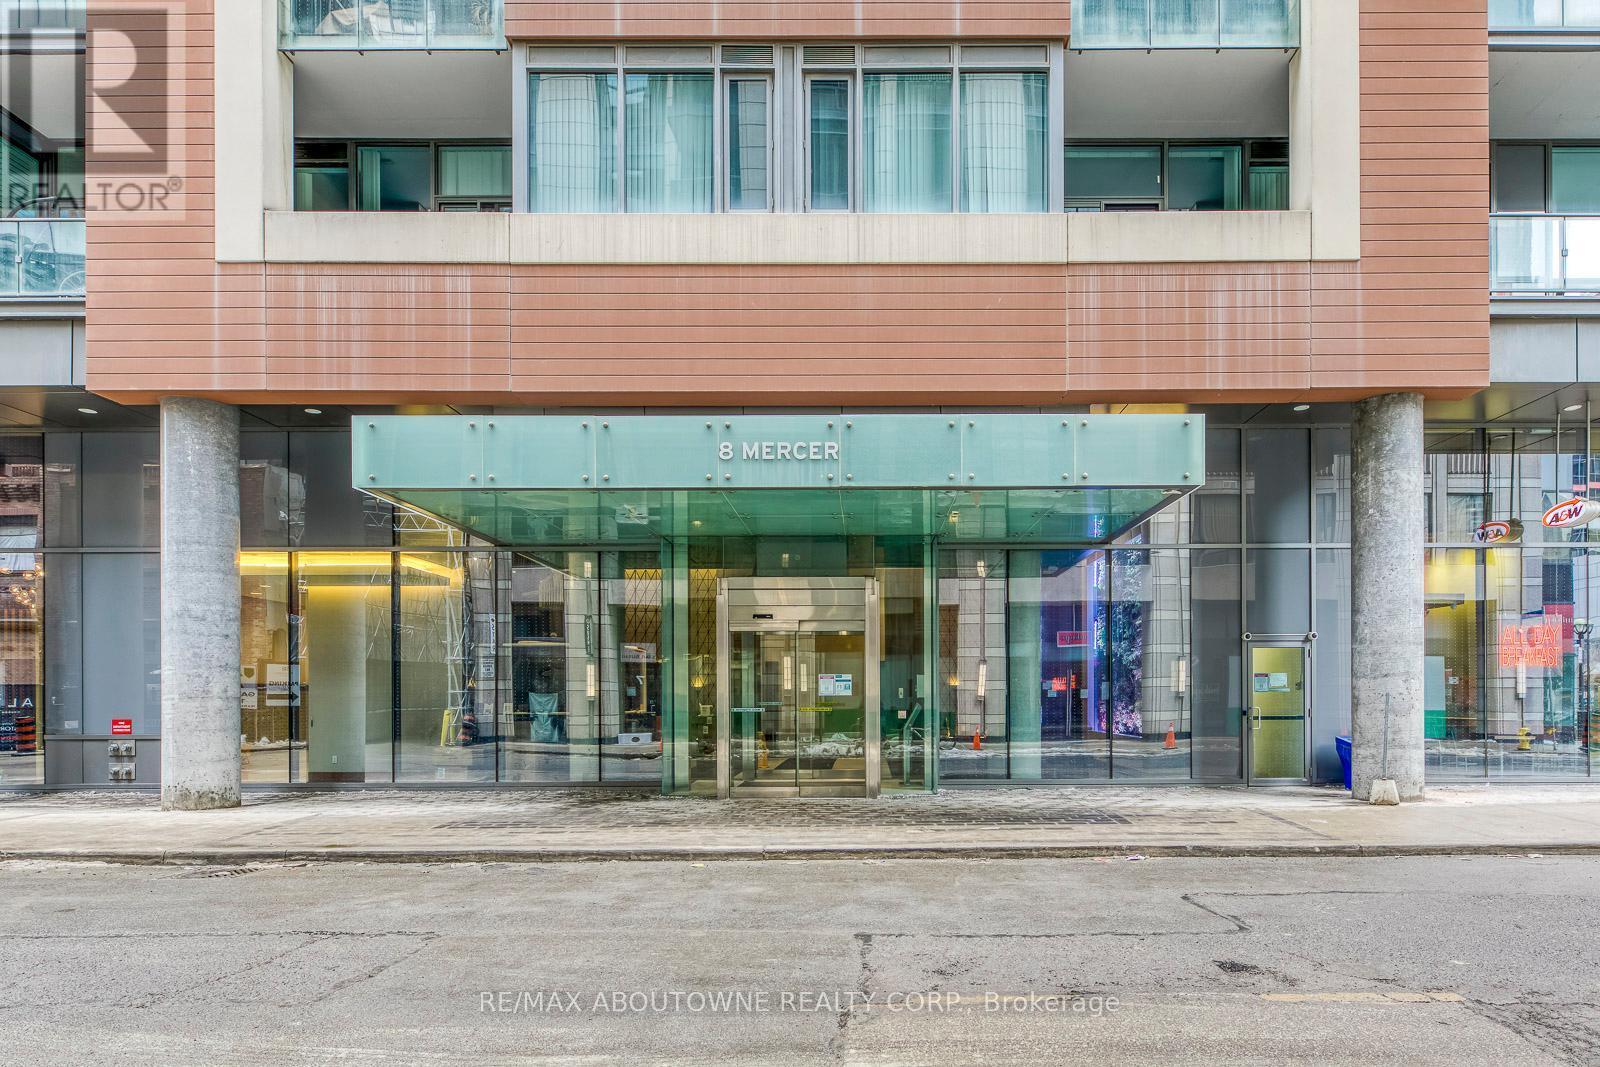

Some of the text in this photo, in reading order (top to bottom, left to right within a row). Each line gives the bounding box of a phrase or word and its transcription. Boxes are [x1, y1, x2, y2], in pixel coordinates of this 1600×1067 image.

[719, 441, 839, 460] 8 MERCER
[1549, 504, 1583, 526] A&W
[1502, 624, 1560, 645] ALL DAY
[1502, 647, 1560, 667] BREAKFAST
